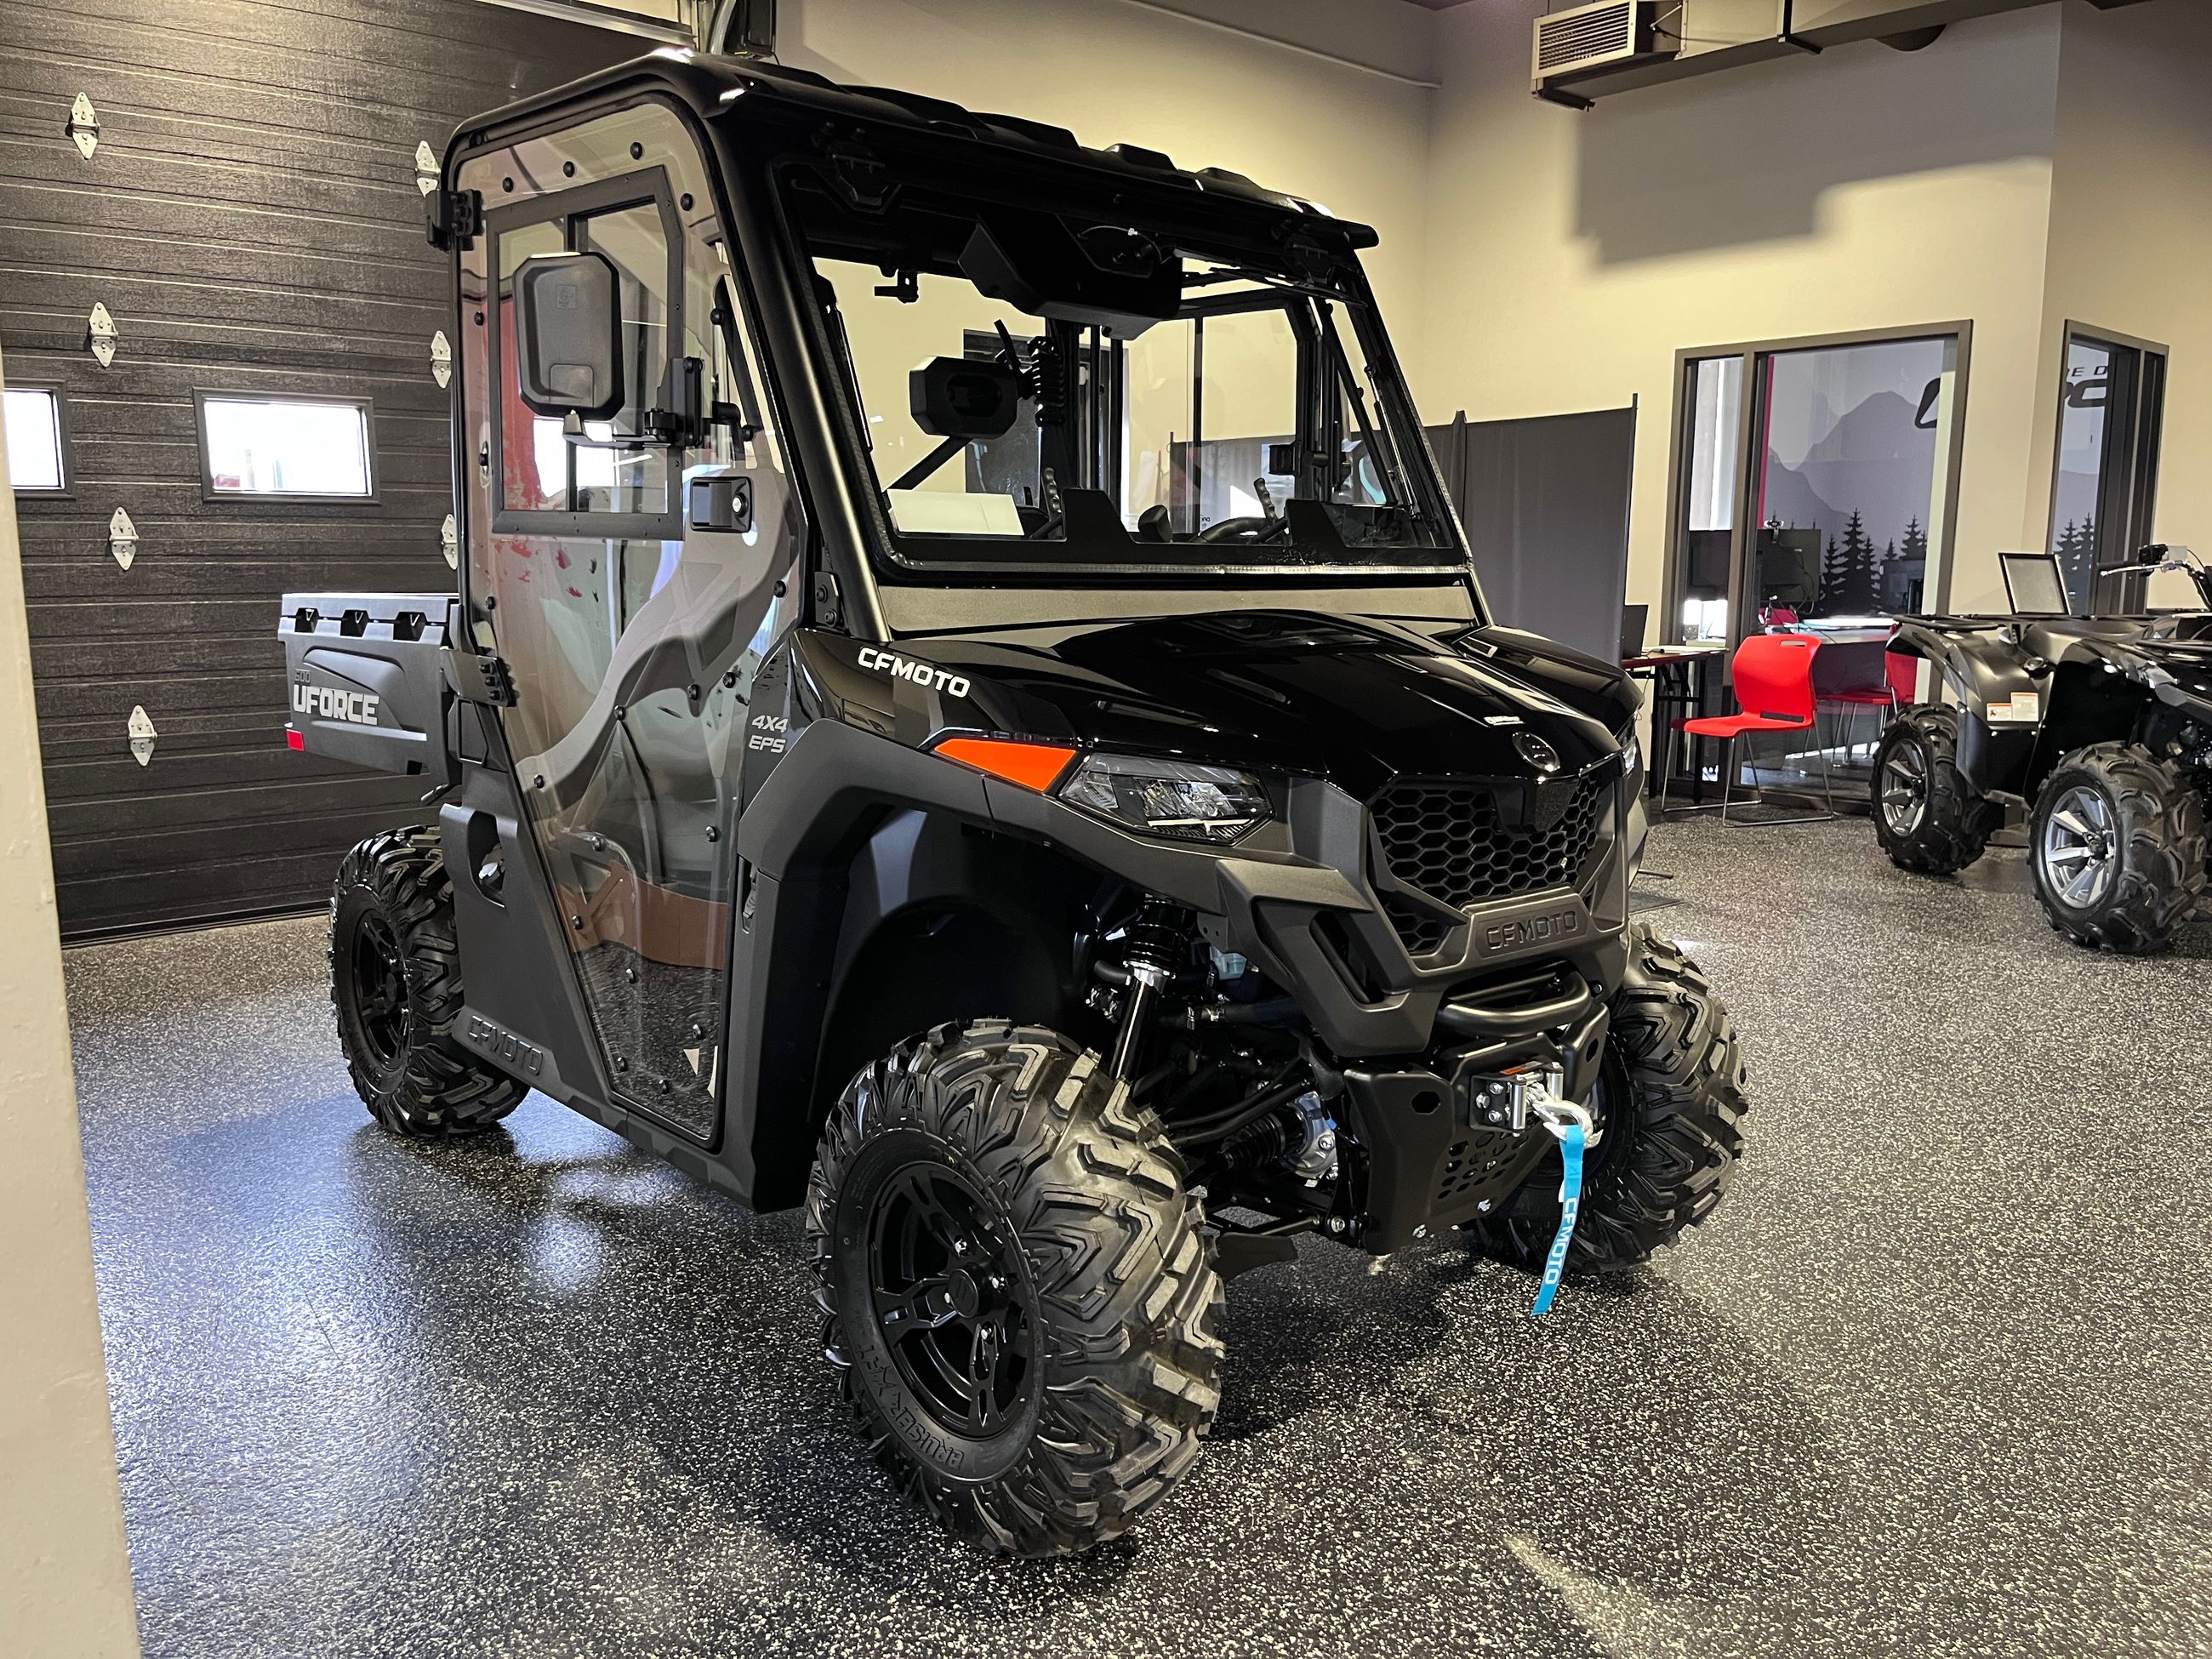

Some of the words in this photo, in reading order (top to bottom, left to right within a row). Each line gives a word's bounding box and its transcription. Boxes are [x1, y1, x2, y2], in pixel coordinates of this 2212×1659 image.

[858, 647, 971, 698] CFMOTO
[293, 684, 379, 726] UFORCE
[751, 715, 789, 733] 4X4
[749, 734, 786, 753] EPS
[1485, 910, 1578, 950] CFMOTO
[468, 1015, 544, 1076] CFMOTO
[1544, 1196, 1578, 1285] CFMOTO
